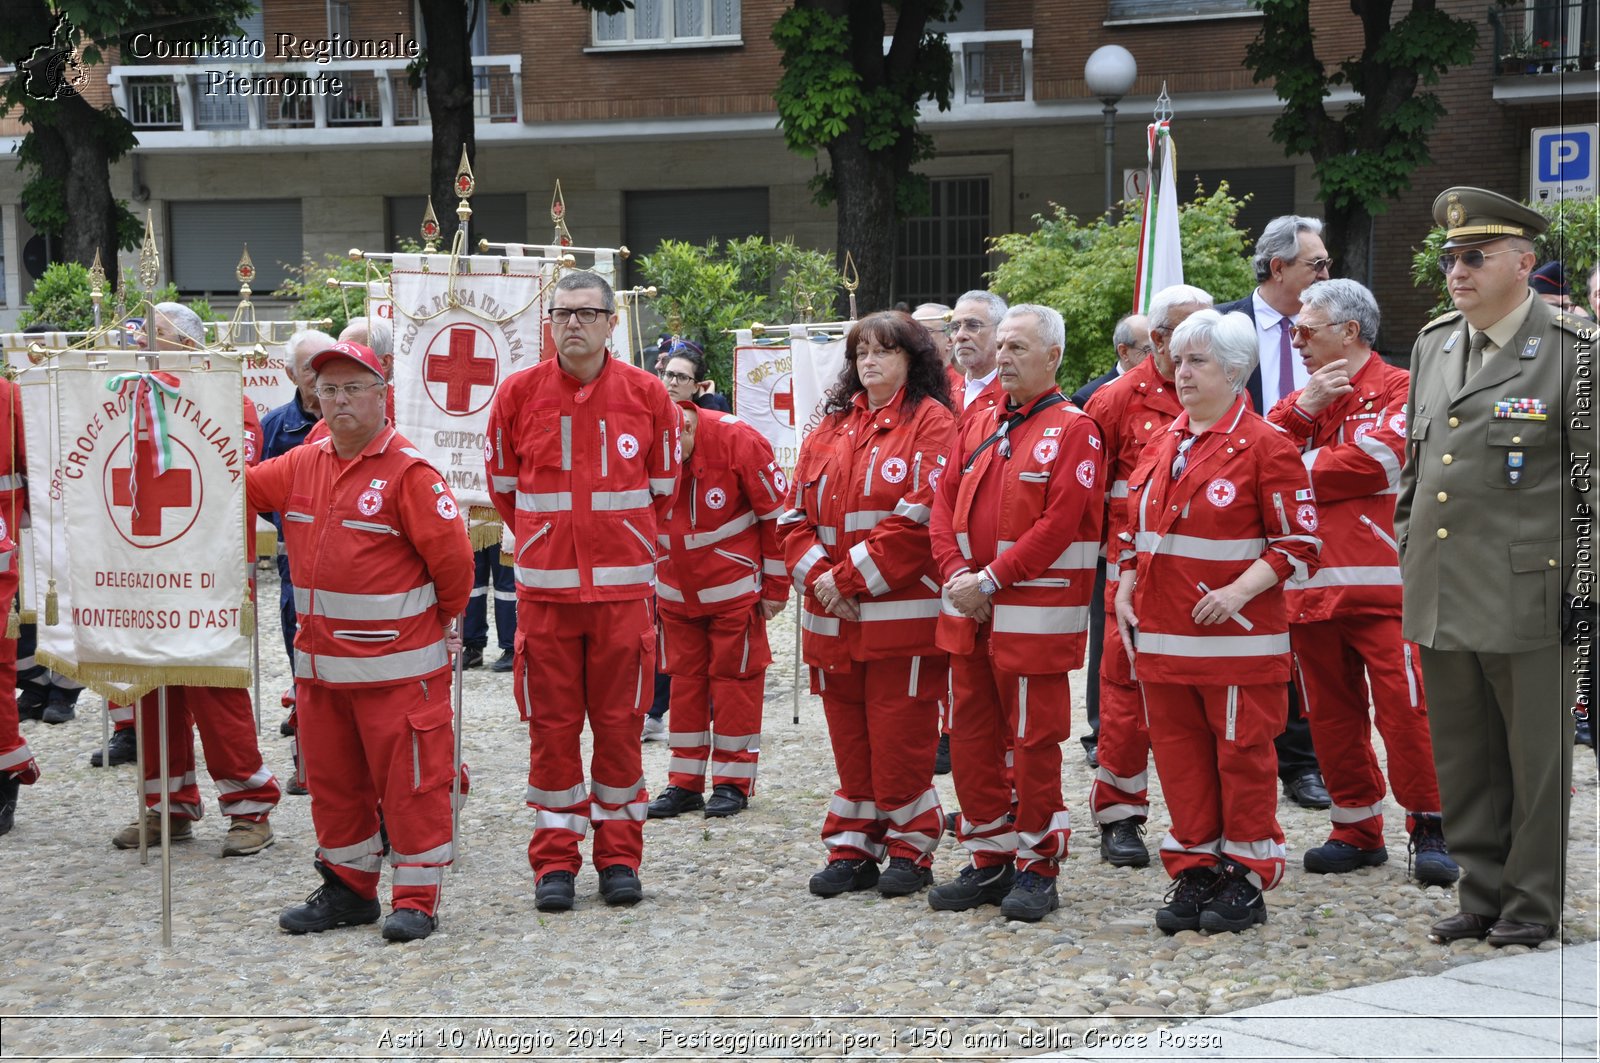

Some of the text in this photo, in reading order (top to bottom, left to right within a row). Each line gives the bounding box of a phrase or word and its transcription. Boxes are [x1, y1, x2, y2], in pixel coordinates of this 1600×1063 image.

[1550, 140, 1579, 176] P
[400, 304, 431, 355] CROCE
[480, 293, 525, 364] ITALIANA
[247, 357, 285, 369] ROSS
[243, 376, 279, 387] IANA
[65, 413, 104, 479] CROCE
[174, 396, 241, 483] ITALIANA
[434, 430, 486, 450] GRUPPO
[451, 452, 463, 466] DI
[446, 470, 482, 490] ANCA
[95, 571, 215, 589] DELEGAZIONE DI
[72, 607, 239, 629] MONTEGROSSO D'AST
